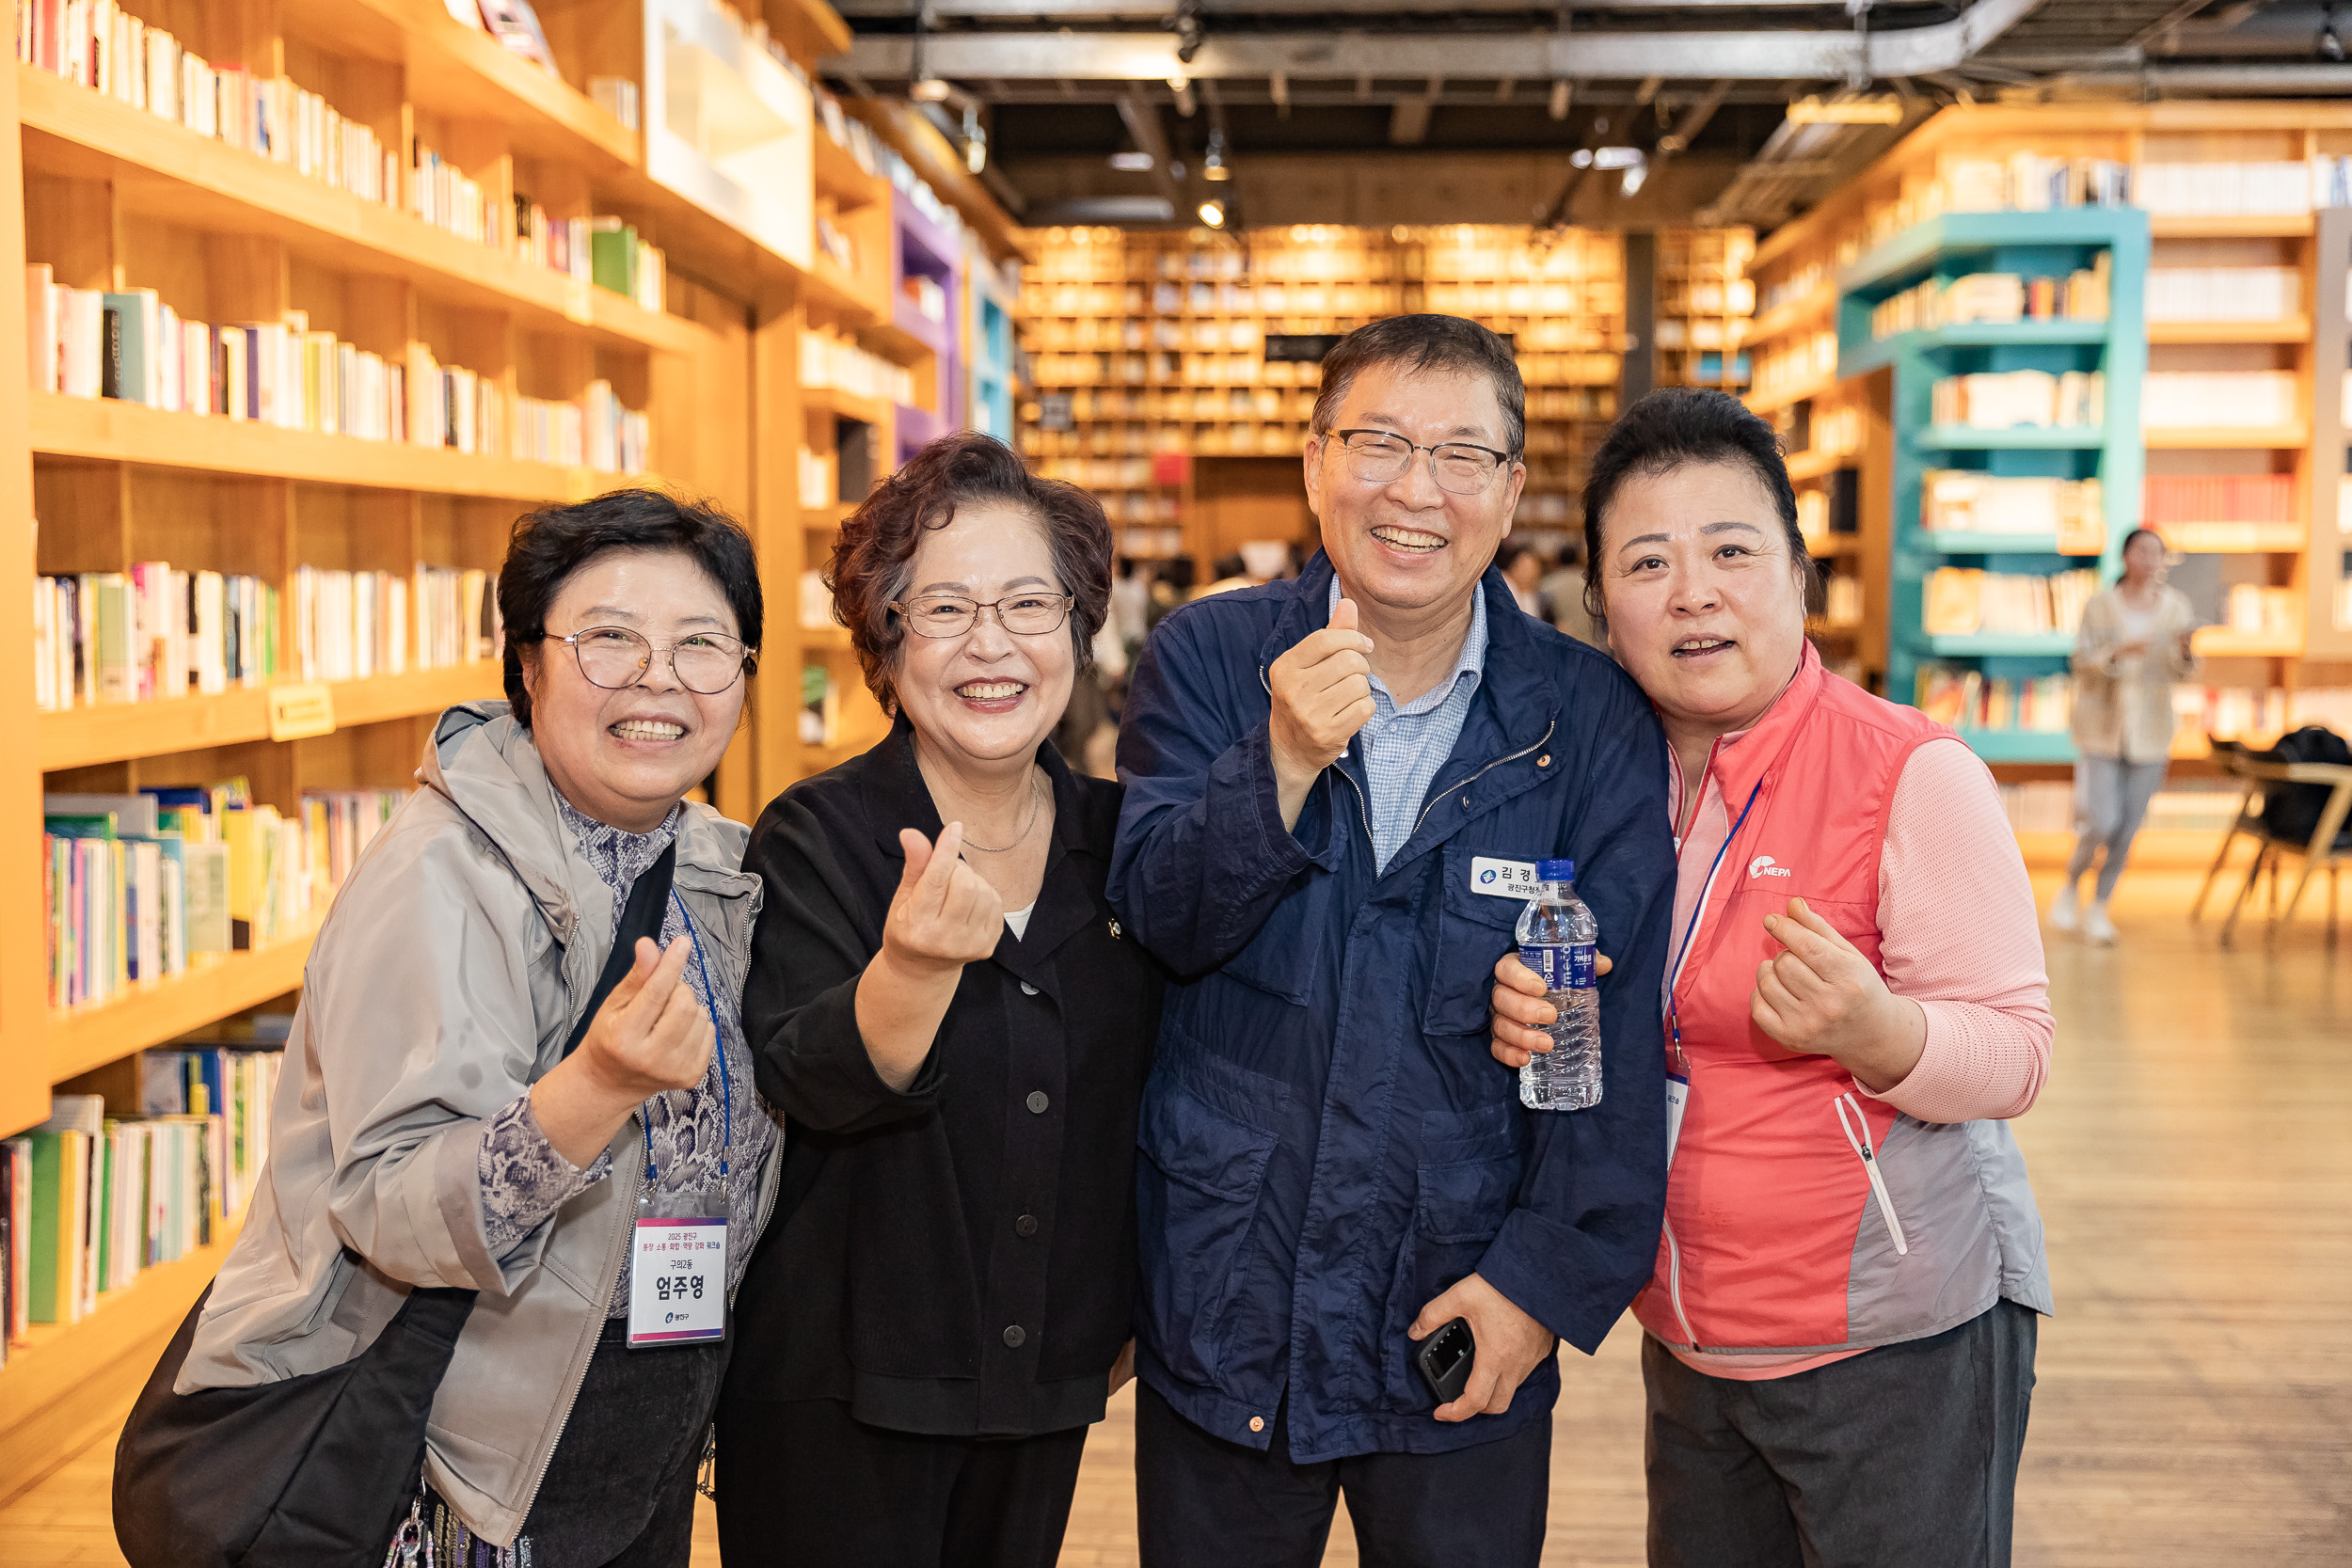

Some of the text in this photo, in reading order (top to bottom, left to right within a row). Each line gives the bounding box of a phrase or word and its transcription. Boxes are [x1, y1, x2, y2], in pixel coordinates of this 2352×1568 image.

[1502, 866, 1531, 882] 김 경
[1763, 866, 1791, 878] NEPA
[668, 1232, 697, 1241] 2025 광진구
[670, 1259, 693, 1270] 구의2동
[657, 1275, 704, 1300] 엄주영
[675, 1313, 690, 1322] 광진구
